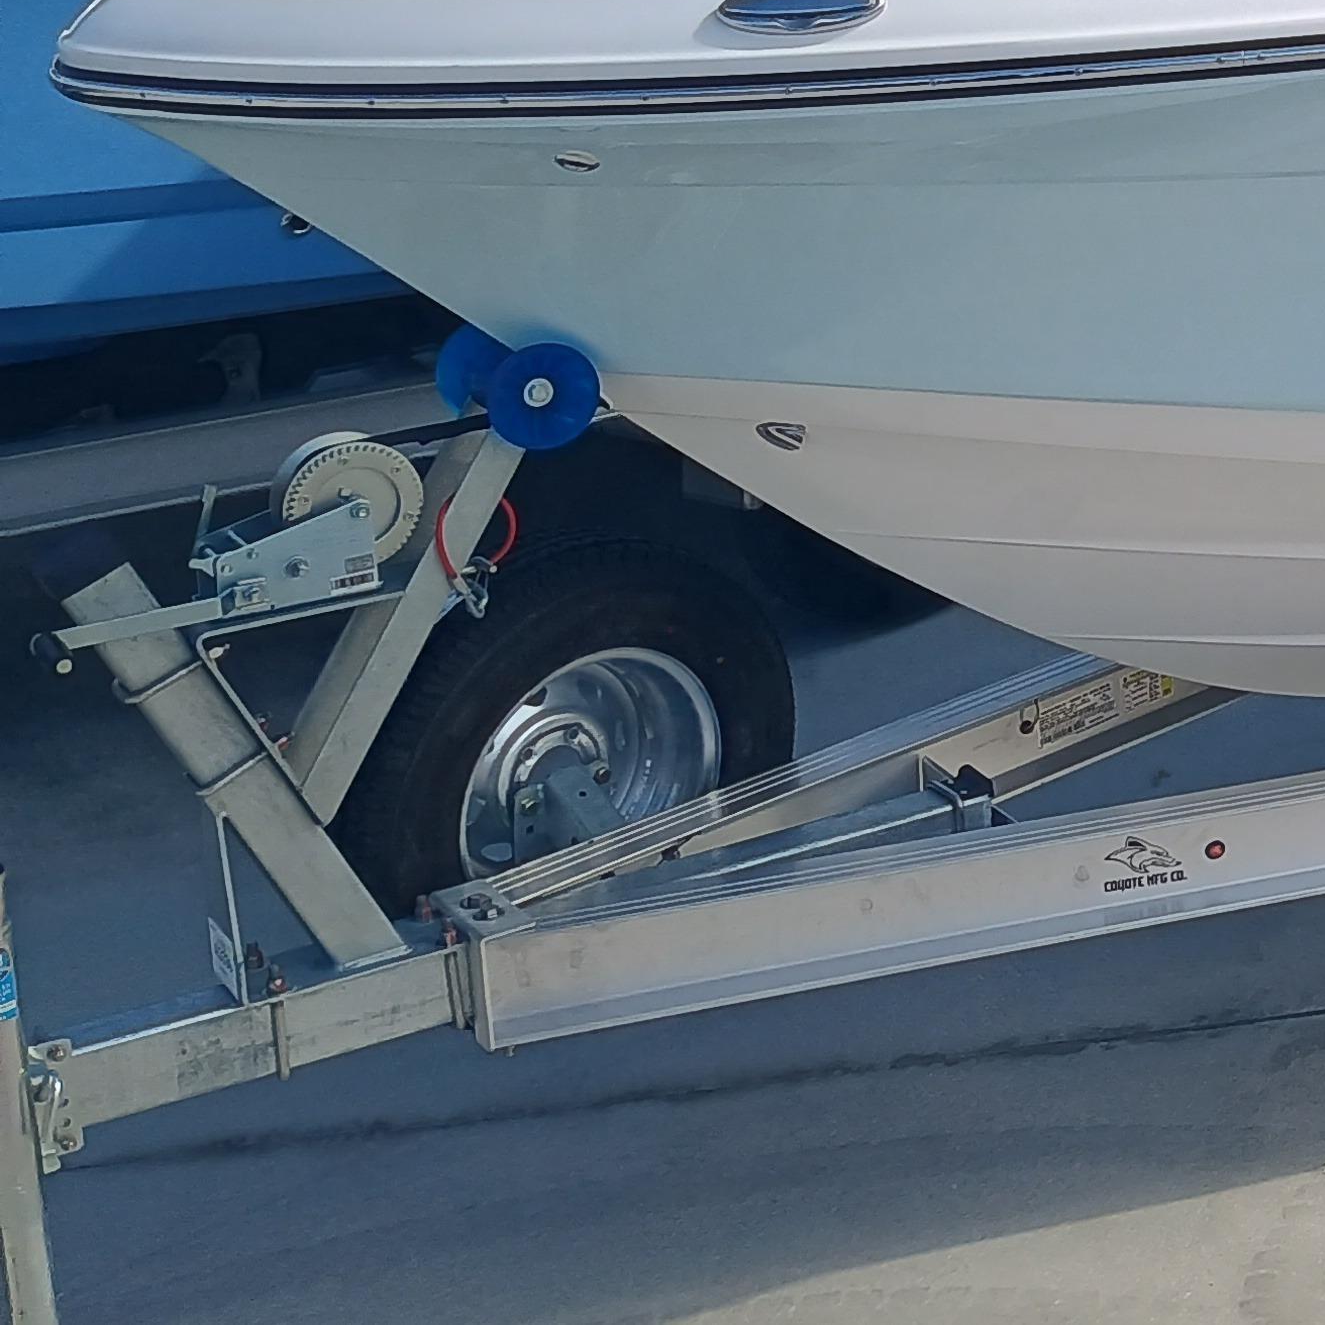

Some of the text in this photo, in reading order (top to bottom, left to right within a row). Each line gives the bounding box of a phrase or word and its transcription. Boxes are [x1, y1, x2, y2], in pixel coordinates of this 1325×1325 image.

[1104, 869, 1188, 893] COYOTE MFG CO.
